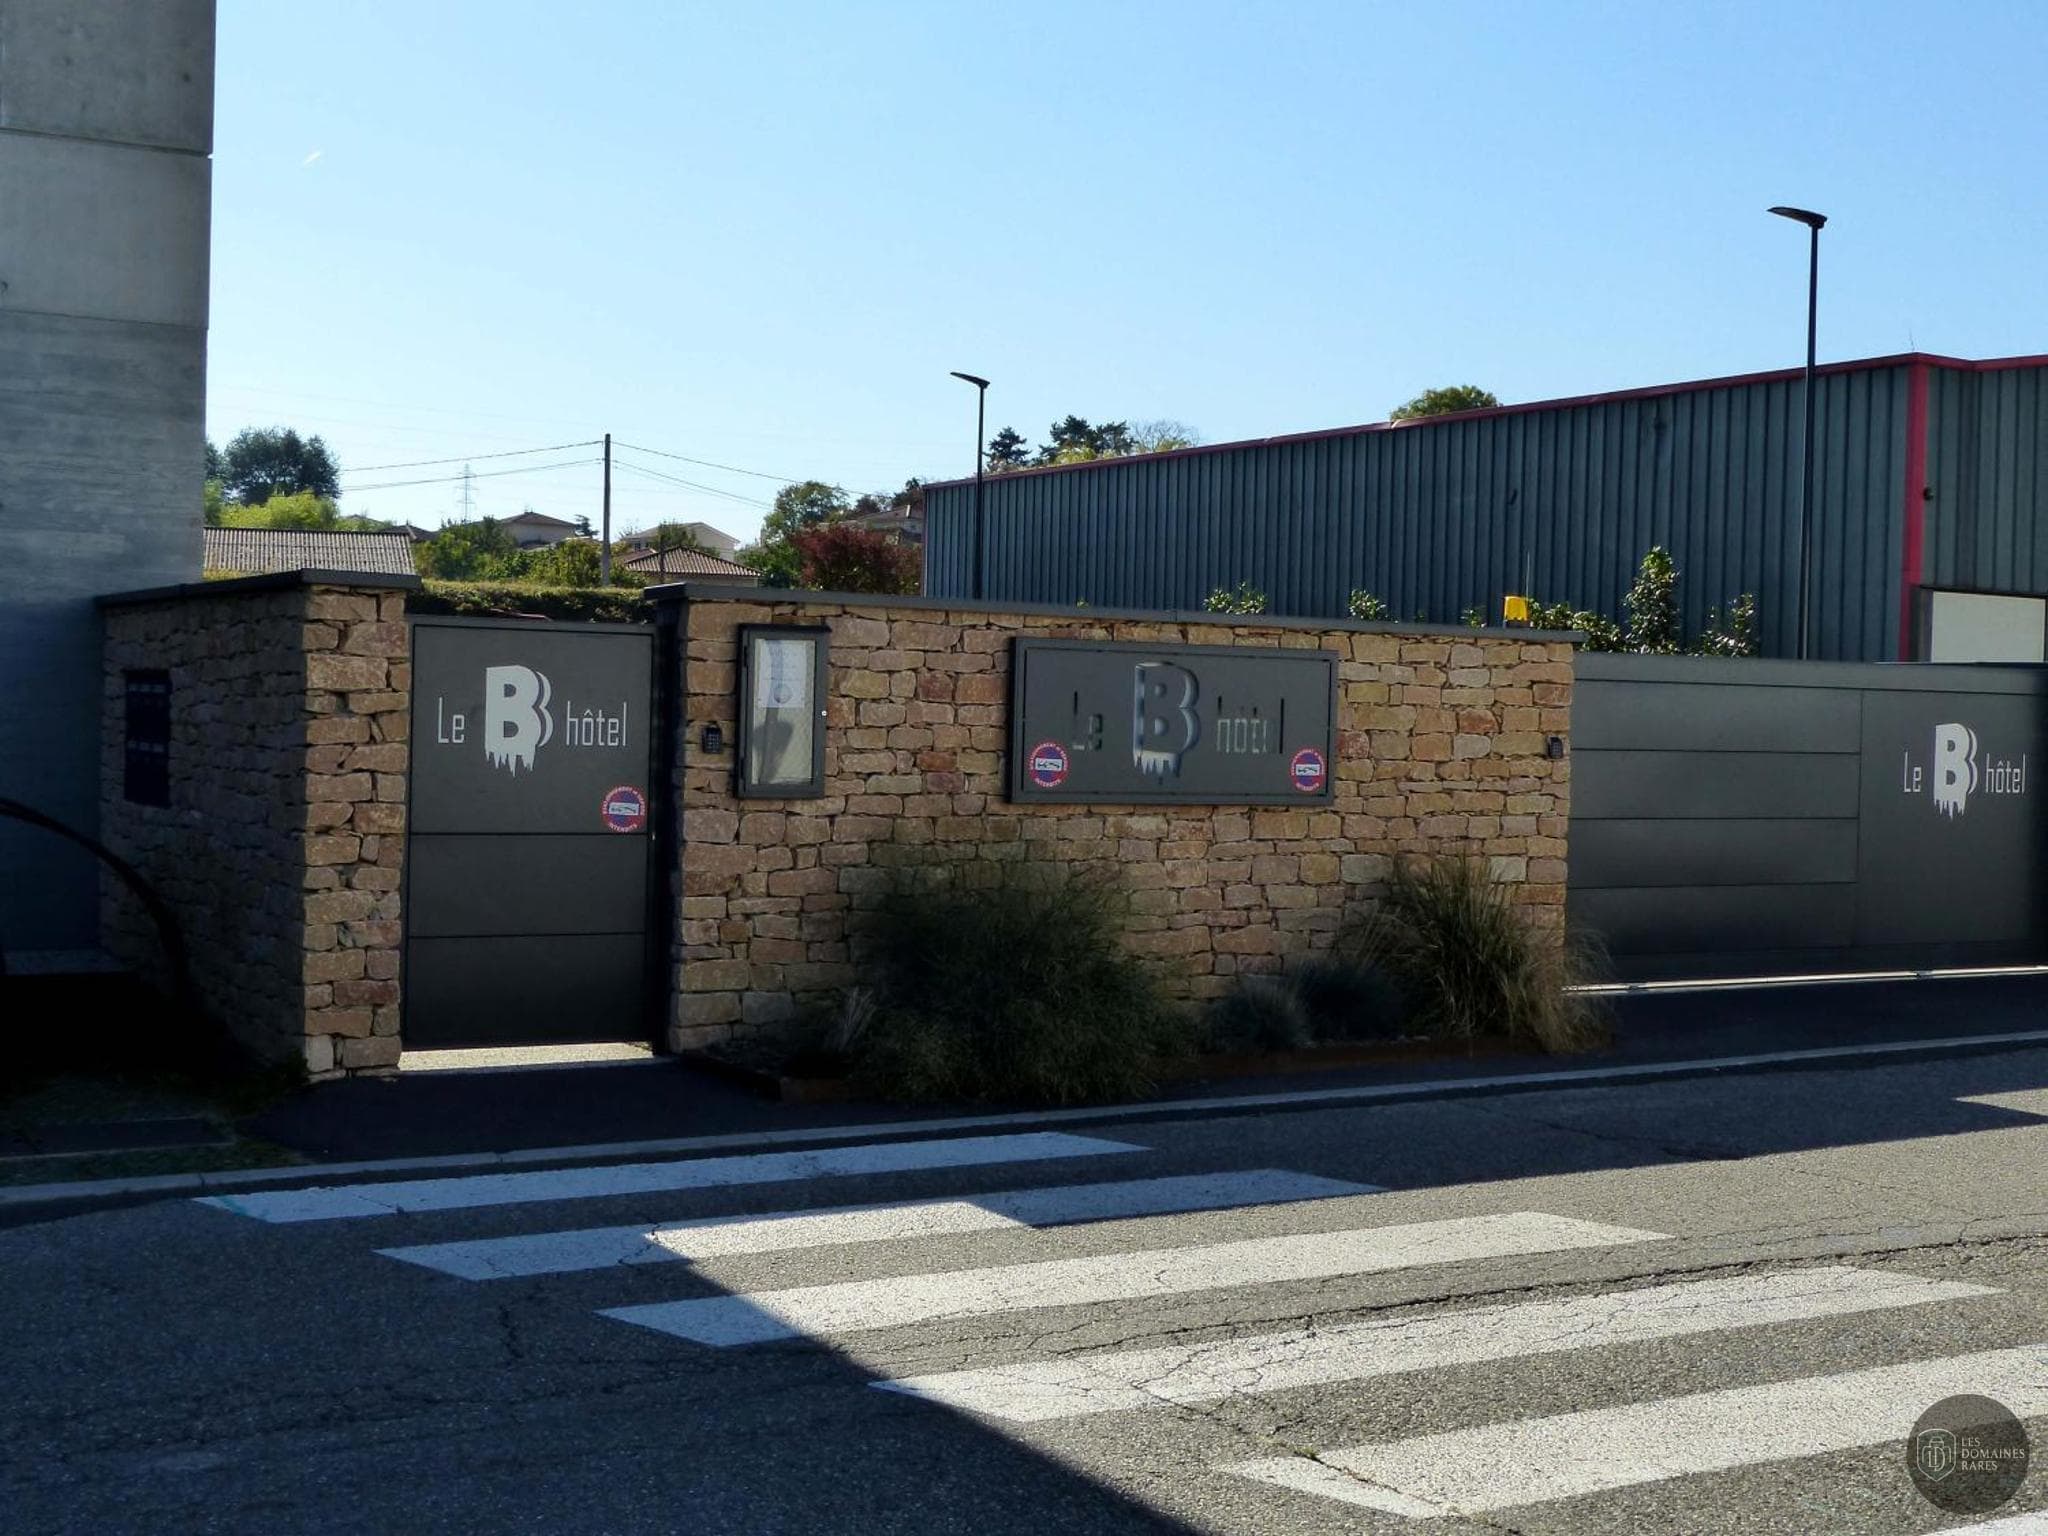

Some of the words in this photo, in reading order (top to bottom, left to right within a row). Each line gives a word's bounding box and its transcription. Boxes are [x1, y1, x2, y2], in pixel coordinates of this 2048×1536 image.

[437, 697, 465, 743] Le
[484, 665, 554, 777] B
[565, 701, 627, 747] hôtel
[1132, 661, 1199, 785] B
[1904, 751, 1922, 793] Le
[1933, 723, 1978, 820] B
[1985, 752, 2026, 794] hôtel
